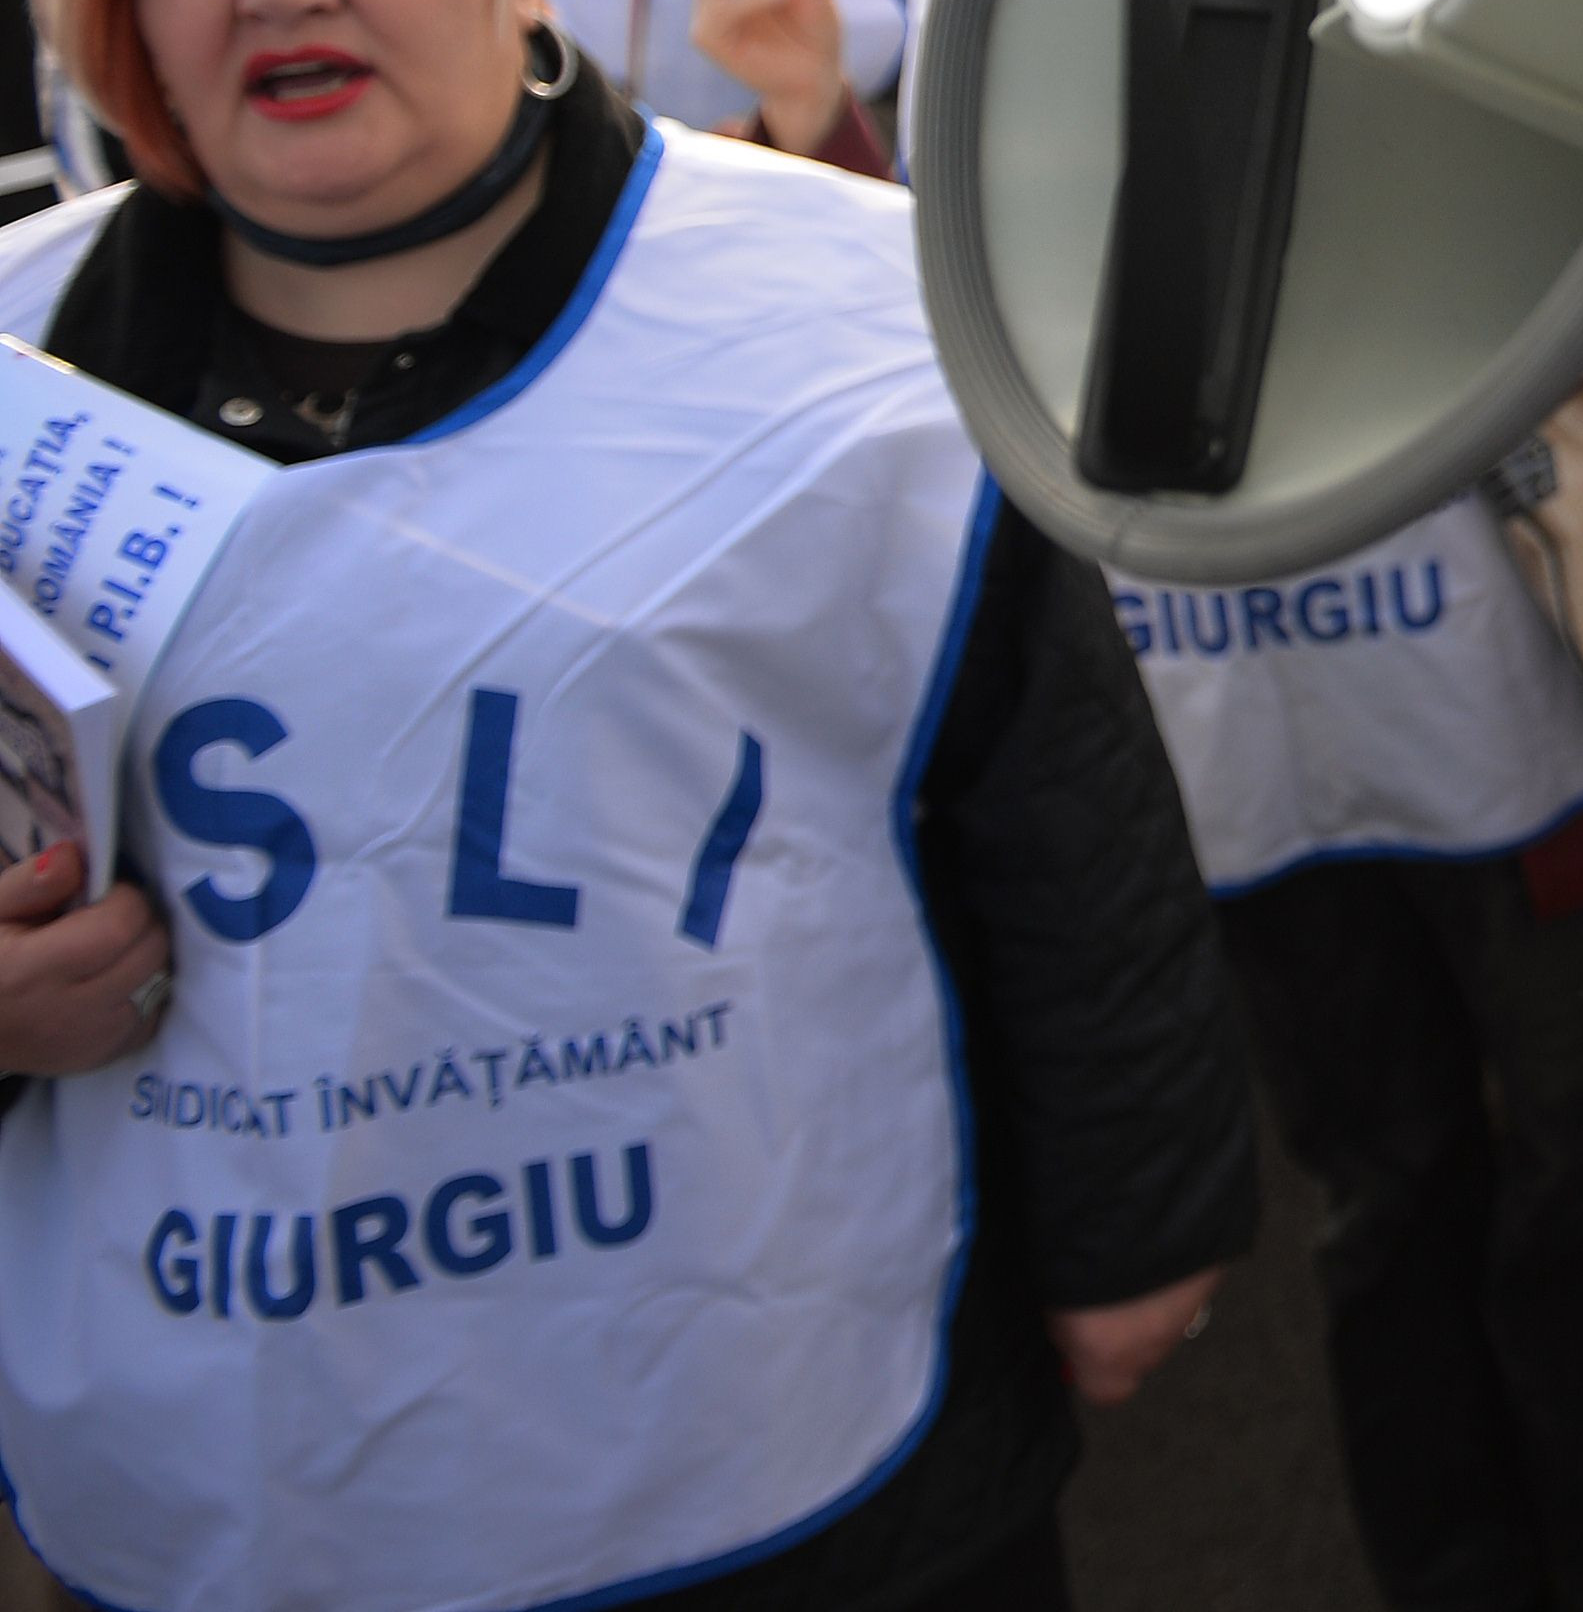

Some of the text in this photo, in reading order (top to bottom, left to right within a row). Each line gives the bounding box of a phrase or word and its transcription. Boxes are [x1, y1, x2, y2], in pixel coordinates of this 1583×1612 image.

[88, 523, 182, 641] P.I.B.
[1113, 557, 1443, 658] GIURGIU
[314, 996, 734, 1135] ÎNVĂȚĂMÂNT
[145, 1139, 657, 1325] GIURGIU
